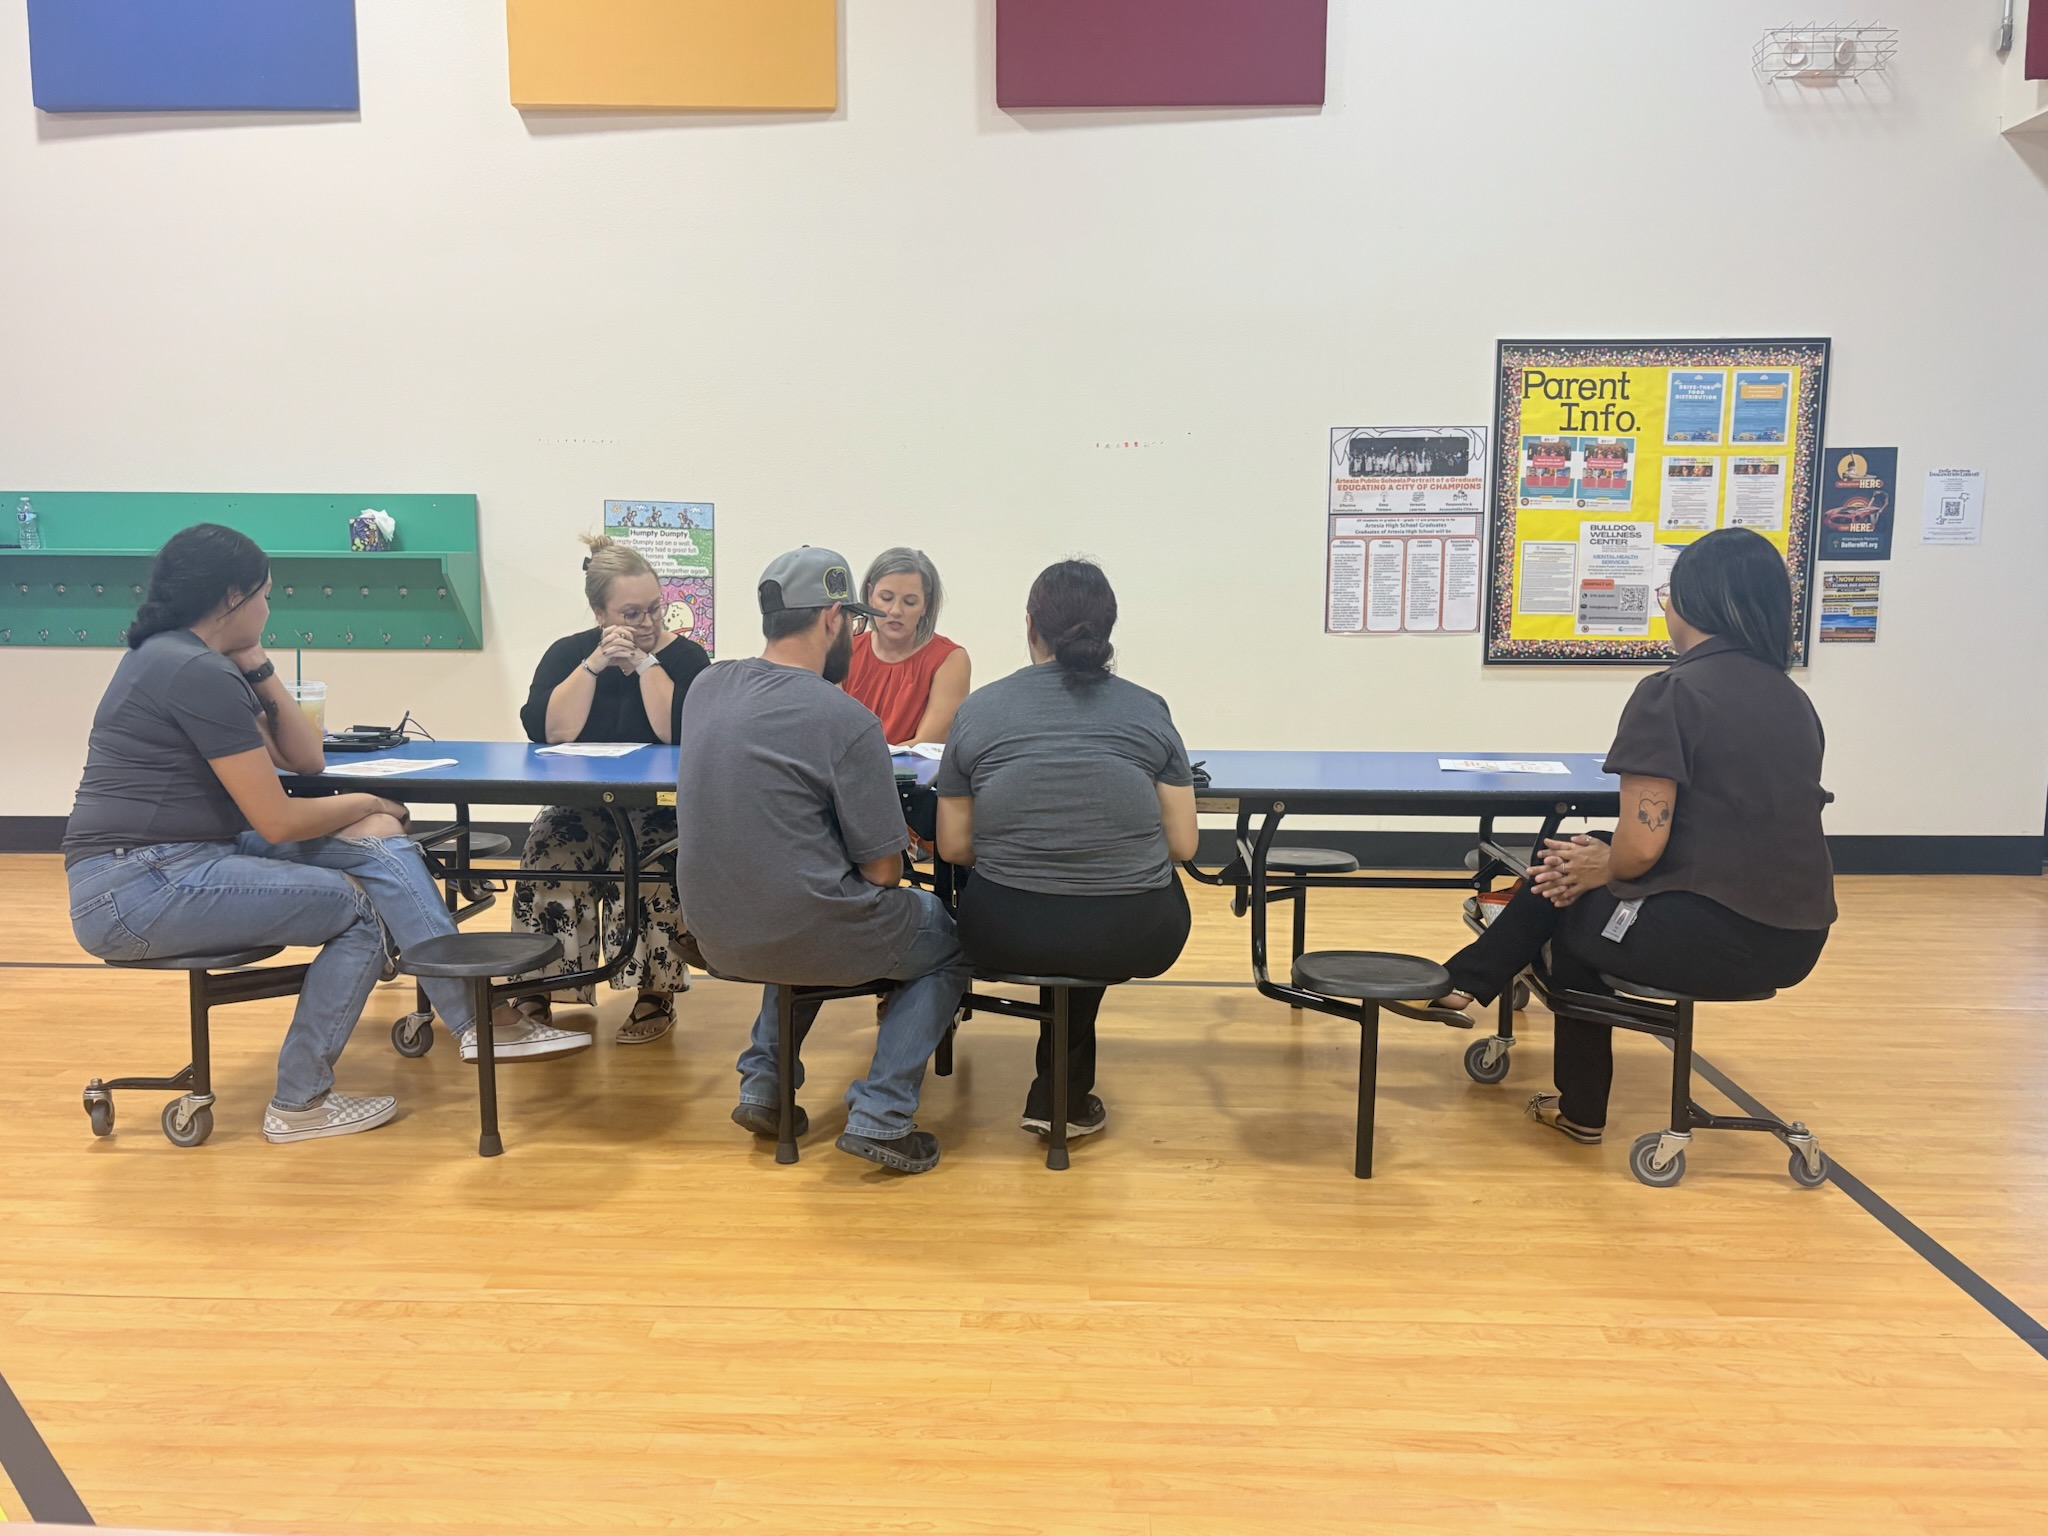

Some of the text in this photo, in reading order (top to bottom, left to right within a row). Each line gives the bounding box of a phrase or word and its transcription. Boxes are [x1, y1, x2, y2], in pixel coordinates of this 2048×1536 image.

[1522, 370, 1631, 401] Parent
[1559, 402, 1641, 433] Info.
[1859, 479, 1881, 489] HERE
[1850, 523, 1874, 532] HERE.
[630, 529, 688, 538] Humpty Dumpty
